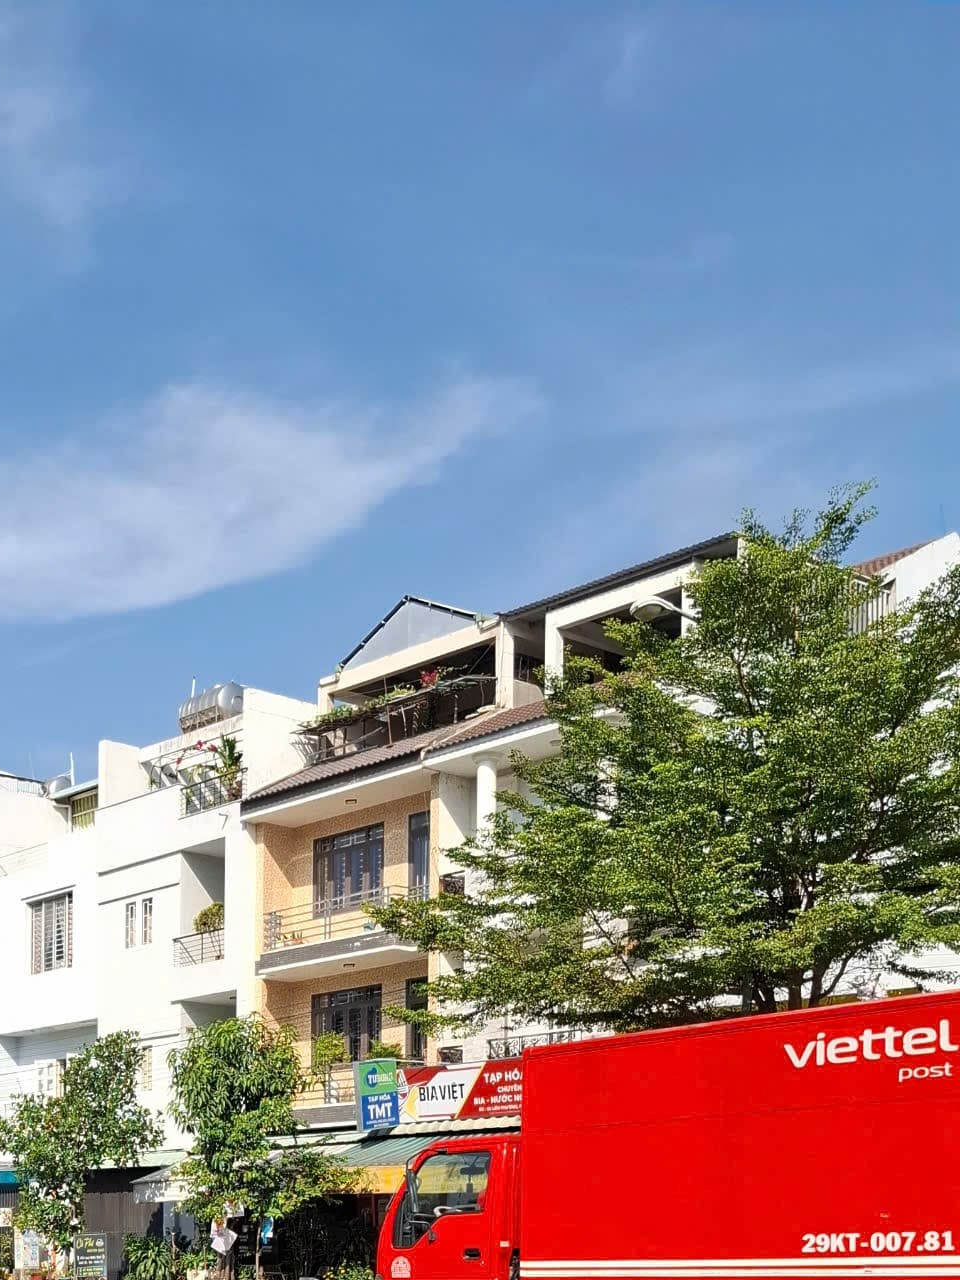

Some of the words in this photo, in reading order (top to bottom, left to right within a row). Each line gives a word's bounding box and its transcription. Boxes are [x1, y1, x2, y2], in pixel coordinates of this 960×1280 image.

[783, 1019, 959, 1068] viettel
[484, 1072, 502, 1085] TẠP
[898, 1062, 953, 1083] post
[419, 1085, 438, 1102] BIA
[439, 1080, 465, 1103] VIỆT
[367, 1102, 393, 1120] TMT
[801, 1230, 955, 1253] 29KT-007.81
